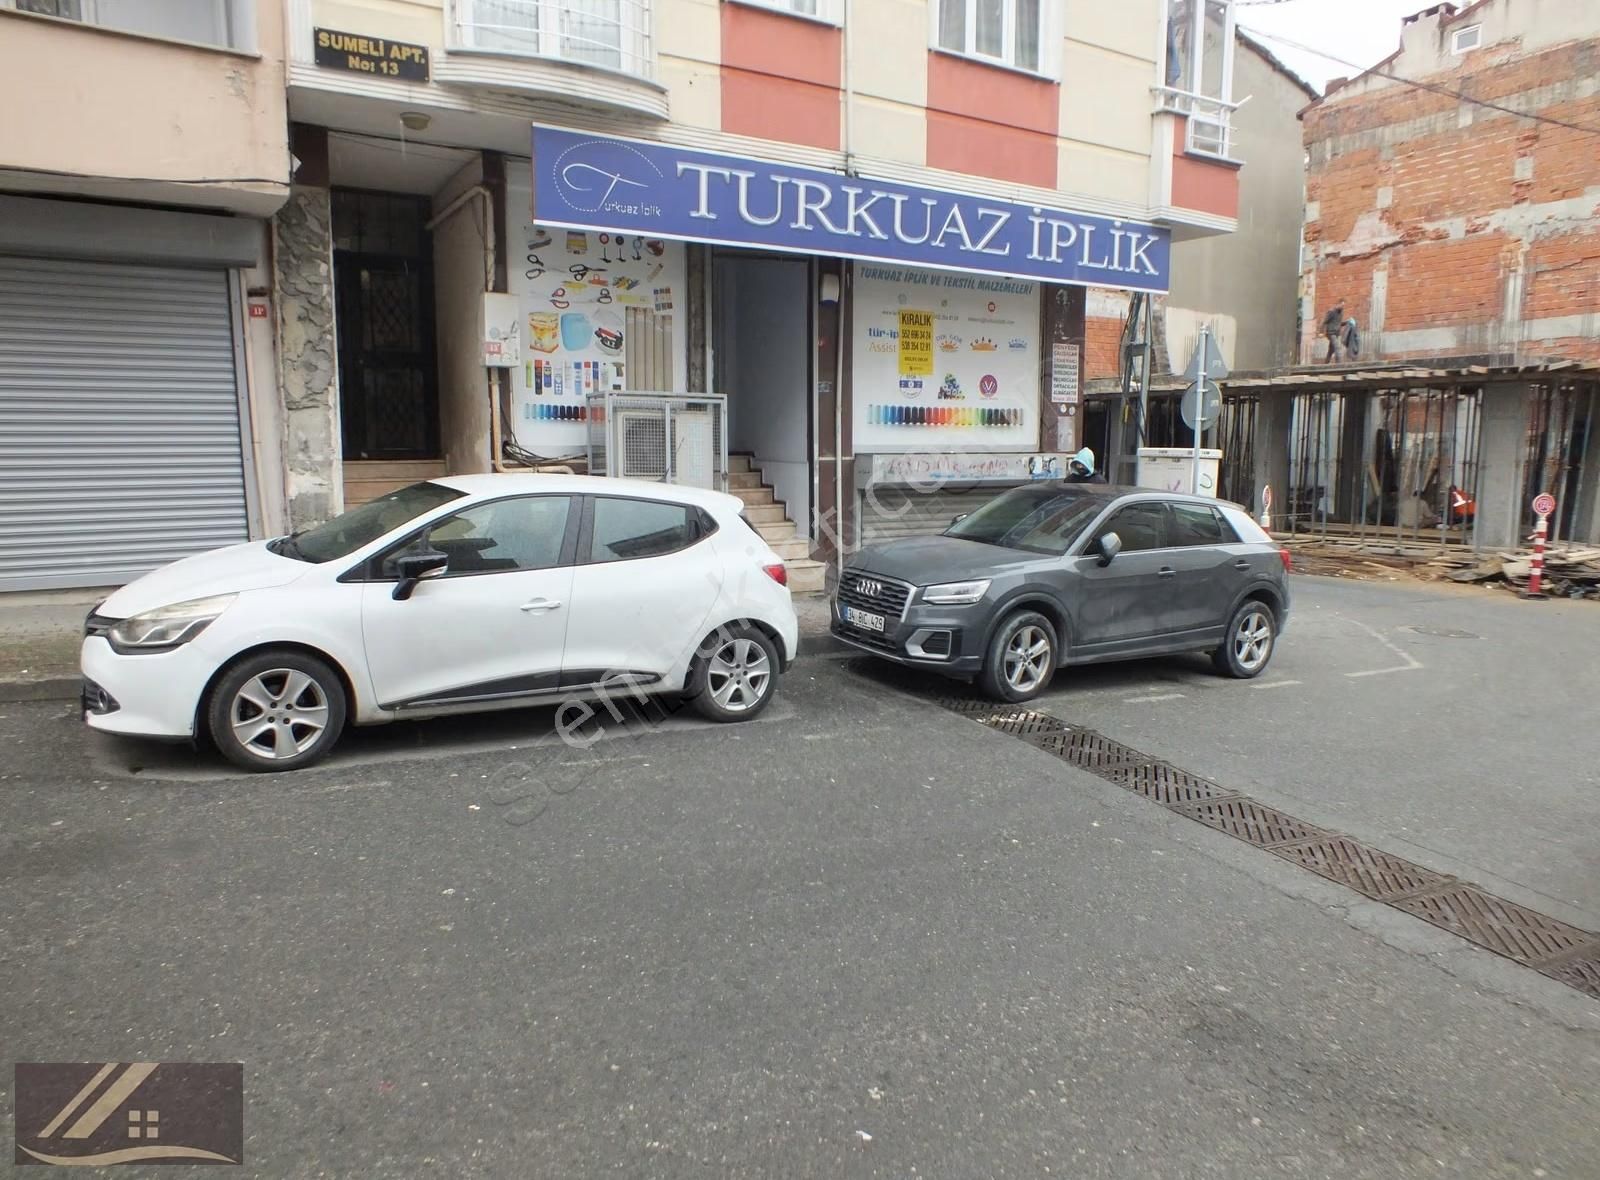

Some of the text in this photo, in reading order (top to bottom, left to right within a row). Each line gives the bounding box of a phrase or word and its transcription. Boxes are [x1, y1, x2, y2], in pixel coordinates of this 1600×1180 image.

[318, 31, 426, 64] SUMELİ APT.
[380, 61, 400, 75] 13
[676, 161, 1160, 276] TURKUAZ İPLİK
[860, 267, 902, 281] TURKUAZ
[903, 270, 929, 284] İPLİK
[930, 274, 943, 286] VE
[943, 276, 976, 289] TEKSTİL
[848, 608, 855, 620] 34
[871, 615, 883, 630] 429
